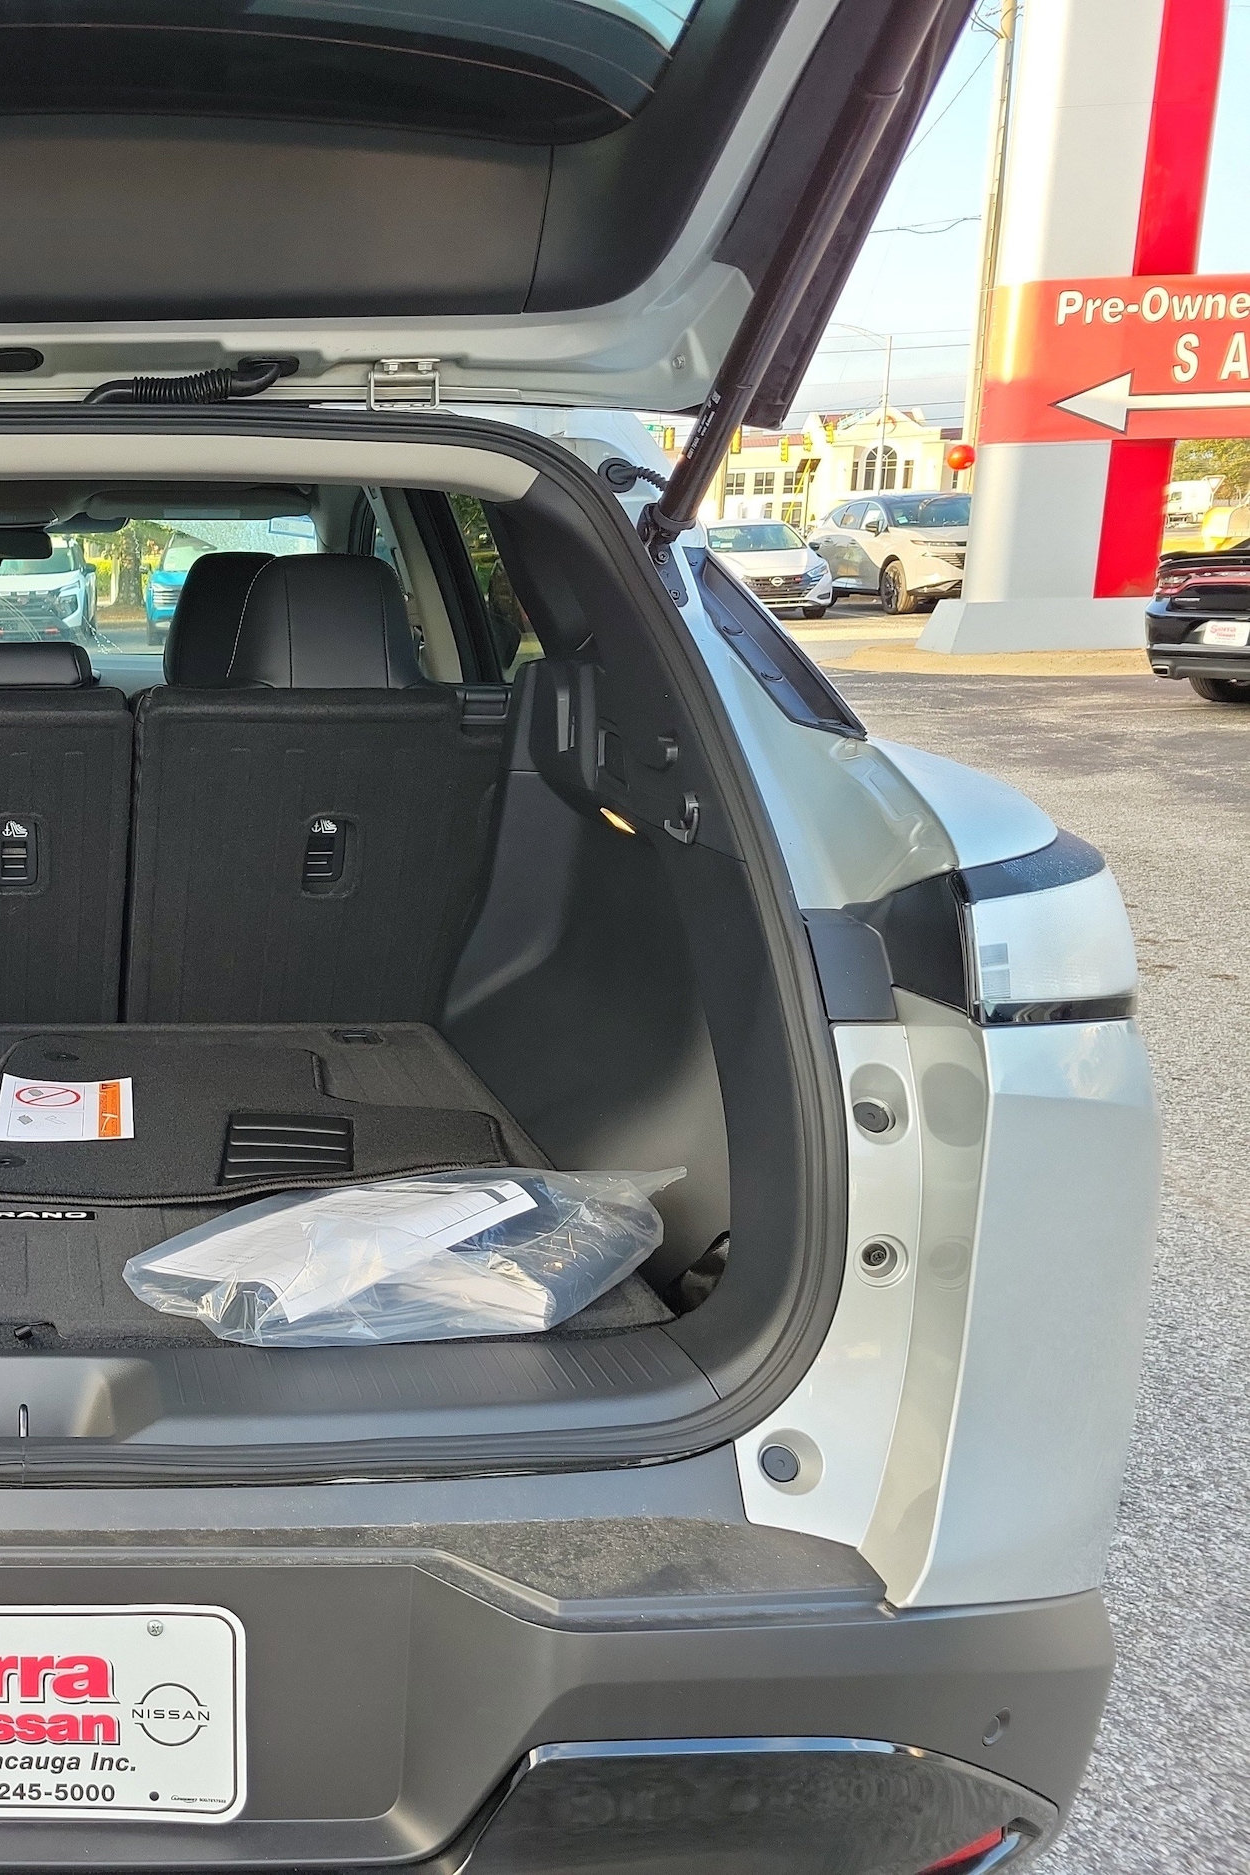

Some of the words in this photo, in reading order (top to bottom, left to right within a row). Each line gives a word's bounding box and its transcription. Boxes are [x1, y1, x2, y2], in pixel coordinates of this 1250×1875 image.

[1056, 286, 1250, 326] Pre-Owne
[131, 1708, 210, 1722] NISSAN
[90, 1751, 137, 1772] Inc.
